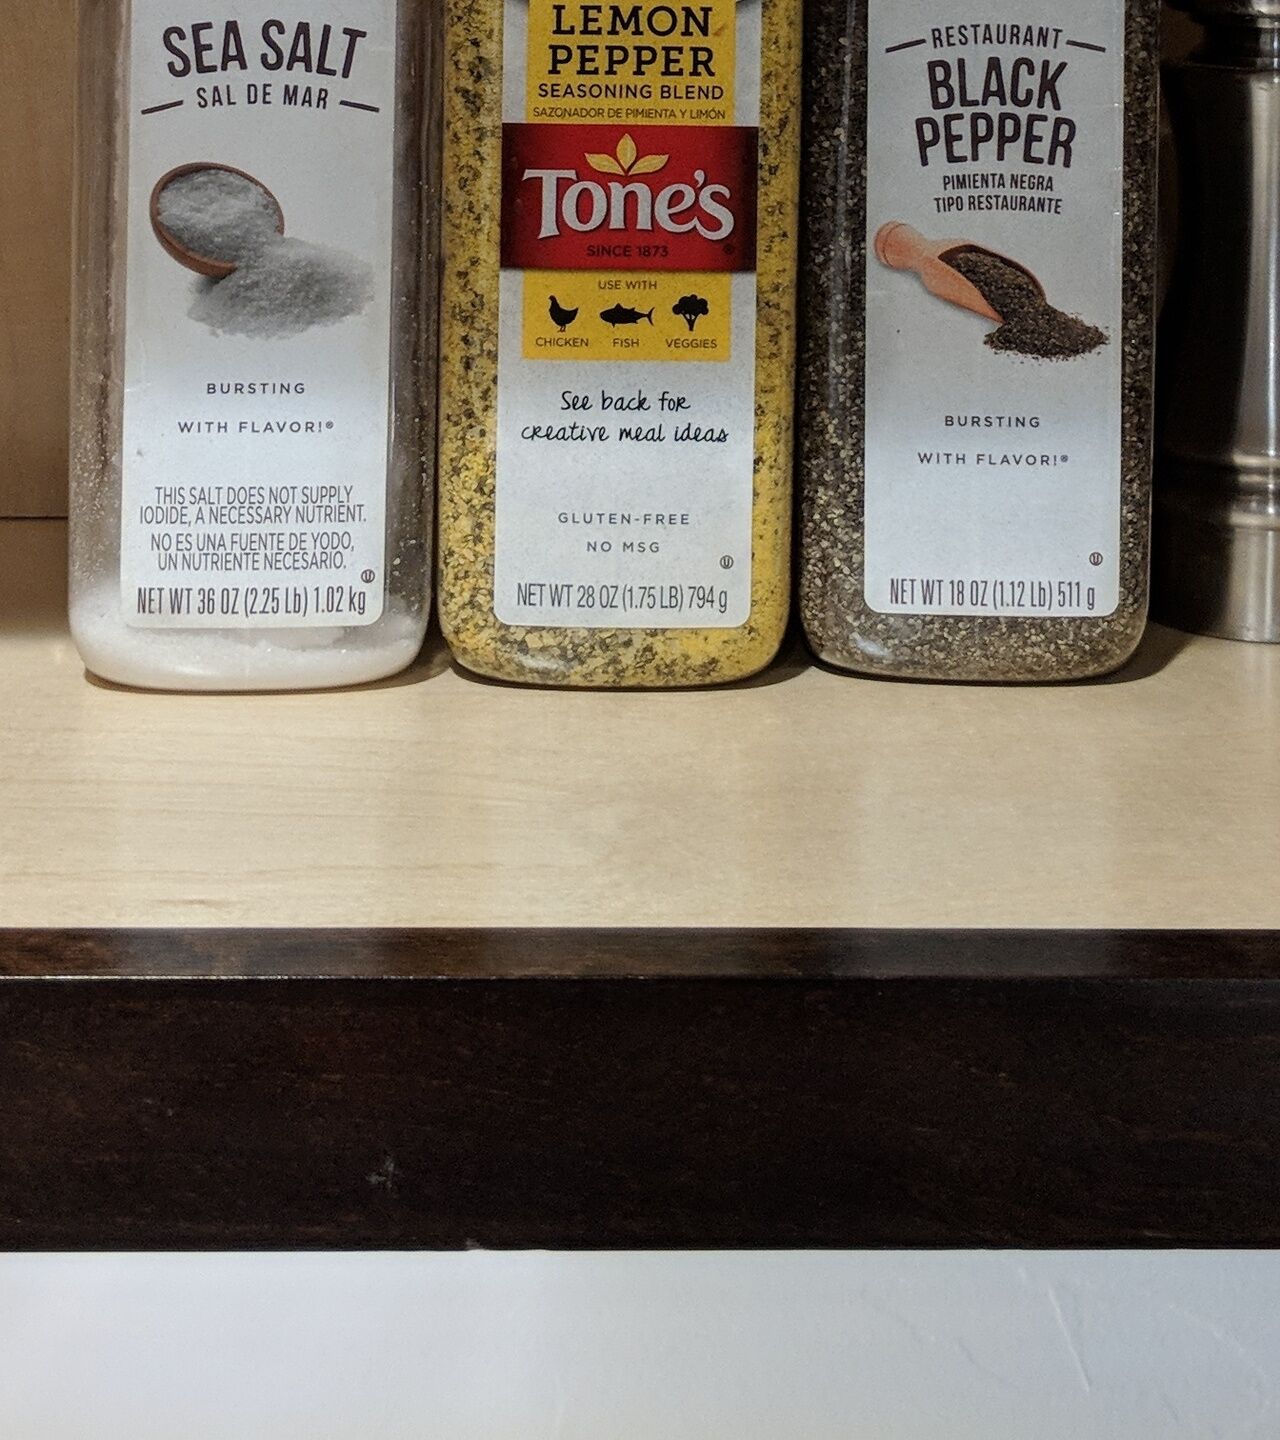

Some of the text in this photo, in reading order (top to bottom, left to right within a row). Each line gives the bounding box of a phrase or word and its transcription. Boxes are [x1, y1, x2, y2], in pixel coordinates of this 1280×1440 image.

[552, 4, 713, 38] LEMON
[931, 23, 1064, 50] RESTAURANT
[162, 18, 367, 79] SEA SALT
[547, 44, 716, 78] PEPPER
[537, 83, 725, 101] SEASONING BLEND
[926, 56, 1069, 112] BLACK
[196, 83, 329, 110] SAL DE MAR
[532, 106, 726, 120] SAZONADOR DE PIMIENTA Y LIMÓN
[915, 112, 1077, 169] PEPPER
[942, 174, 1055, 192] PIMIENTA NEGRA
[521, 168, 735, 241] Tone's
[934, 194, 1063, 215] TIPO RESTAURANTE
[586, 244, 670, 259] SINCE 1873
[597, 279, 658, 291] USE WITH
[535, 337, 590, 348] CHICKEN
[612, 337, 640, 348] FISH
[665, 337, 718, 349] VEGGIES
[206, 382, 306, 395] BURSTING
[561, 389, 692, 412] See back for
[177, 420, 228, 434] WITH
[520, 422, 730, 443] creative meal ideas
[944, 415, 1041, 429] BURSTING
[917, 452, 967, 465] WITH
[154, 485, 354, 506] THIS SALT DOES NOT SUPPLY
[139, 503, 367, 527] IODIDE, A NECESSARY NUTRIENT.
[557, 512, 691, 526] GLUTEN-FREE
[150, 530, 355, 552] NO ES UNA FUENTE DE YODO,
[586, 541, 661, 553] NO MSG
[157, 550, 347, 572] UN NUTRIENTE NECESARIO.
[137, 586, 165, 615] NET
[169, 586, 193, 615] WT
[197, 586, 216, 615] 36
[221, 586, 240, 615] OZ
[244, 586, 280, 618] (2.25
[313, 585, 345, 615] 1.02
[348, 585, 367, 616] kg
[516, 582, 728, 614] NET WT 28 OZ (1.75 LB) 794 g
[889, 577, 917, 605] NET
[920, 578, 945, 606] WT
[948, 578, 966, 607] 18
[969, 579, 989, 608] OZ
[992, 579, 1026, 610] (1.12
[1057, 580, 1082, 608] 511
[1086, 587, 1096, 611] g
